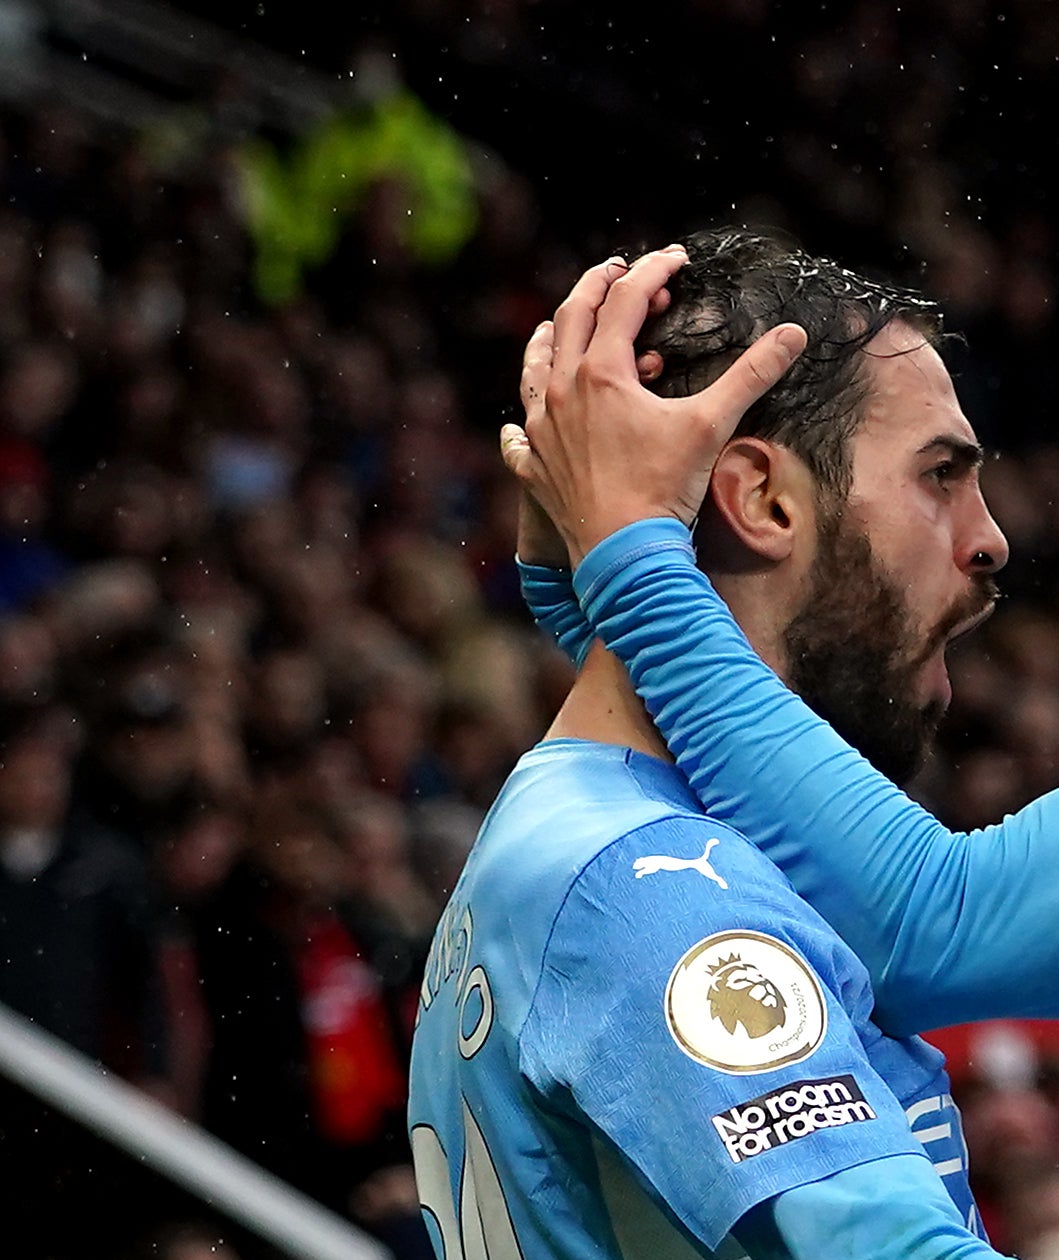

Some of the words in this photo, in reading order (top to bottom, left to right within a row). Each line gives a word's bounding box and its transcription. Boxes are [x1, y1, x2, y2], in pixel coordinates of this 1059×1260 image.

[711, 1105, 767, 1142] No
[765, 1081, 855, 1120] room
[724, 1126, 774, 1164] for
[776, 1099, 878, 1143] racism
